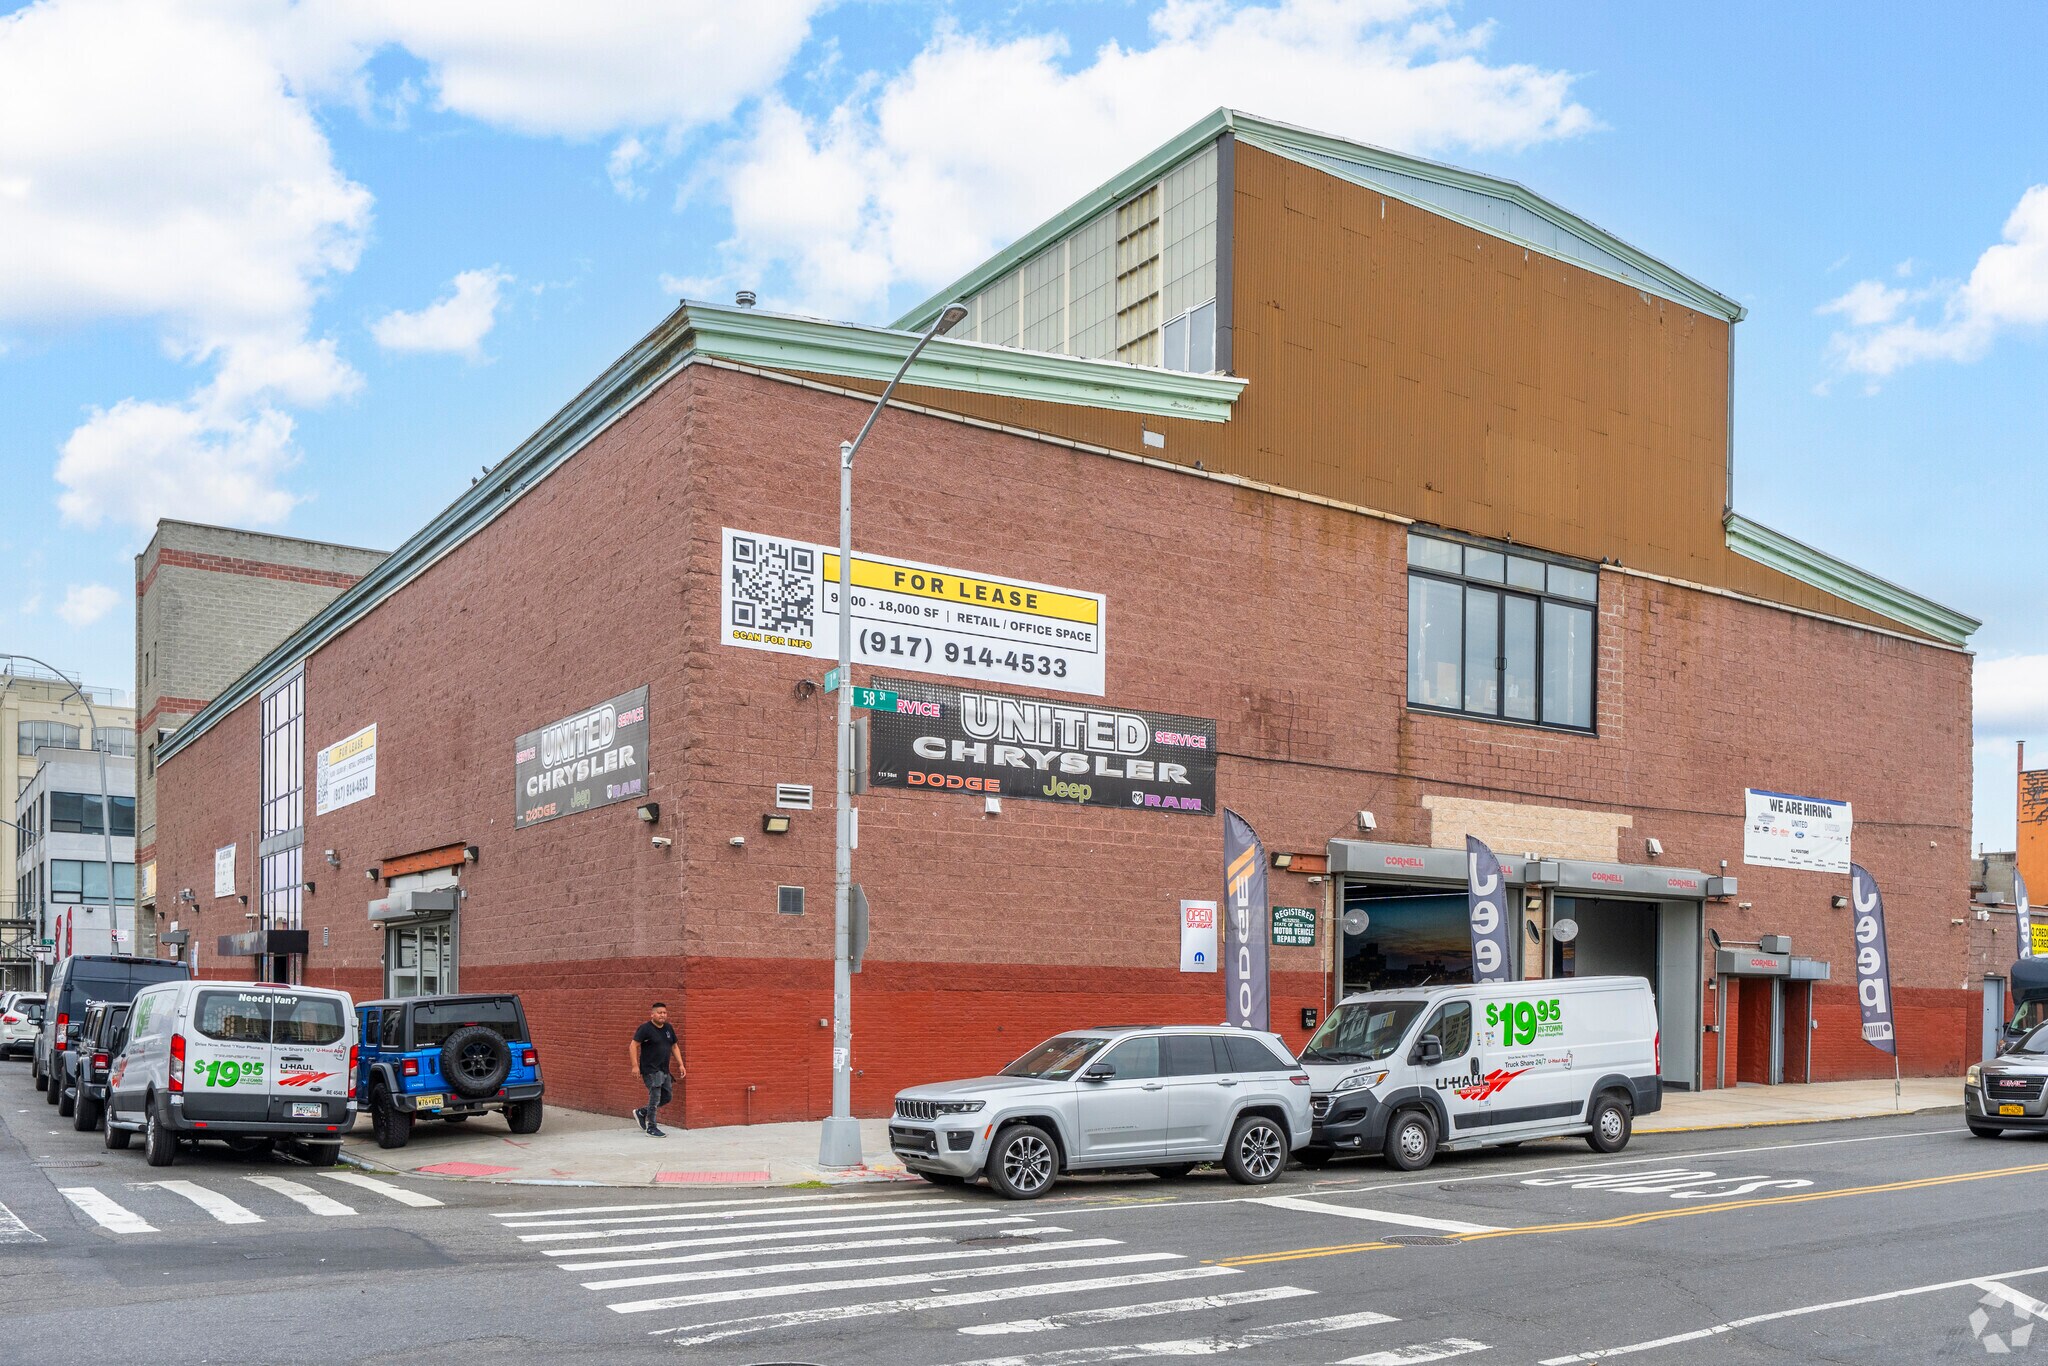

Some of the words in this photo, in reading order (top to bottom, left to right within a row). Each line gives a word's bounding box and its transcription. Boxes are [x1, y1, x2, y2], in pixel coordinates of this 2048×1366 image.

[894, 571, 944, 594] FOR
[960, 582, 1038, 609] LEASE
[830, 593, 866, 607] 900
[878, 600, 920, 615] 18,000
[923, 607, 940, 618] SF
[957, 612, 1000, 629] RETAIL
[1010, 621, 1052, 636] OFFICE
[1055, 628, 1092, 643] SPACE
[733, 629, 761, 642] SCAN
[764, 634, 785, 646] FOR
[788, 637, 812, 649] INFO
[859, 628, 933, 664] (917)
[944, 642, 1067, 678] 914-4533
[863, 690, 875, 706] 58
[896, 699, 940, 718] RVICE
[960, 692, 1150, 756] UNITED
[1154, 730, 1207, 749] SERVICE
[516, 746, 536, 765] SERVICE
[541, 703, 617, 769] UNITED
[617, 706, 644, 729] SERVICE
[348, 737, 363, 754] LEASE
[912, 736, 1192, 785] CHRYSLER
[526, 745, 636, 797] CHRYSLER
[907, 770, 1000, 791] DODGE
[1042, 775, 1092, 803] Jeep
[1144, 793, 1202, 810] RAM
[525, 802, 557, 823] DODGE
[570, 786, 591, 808] Jeep
[612, 778, 641, 799] RAM
[1769, 798, 1783, 813] WE
[1785, 801, 1802, 816] ARE
[1803, 803, 1832, 819] HIRING
[1385, 856, 1424, 867] CORNELL
[1592, 872, 1623, 883] CORNELL
[1668, 879, 1697, 888] CORNELL
[1187, 909, 1211, 921] OPEN
[1274, 908, 1315, 921] REGISTERED
[1273, 927, 1293, 935] MOTOR
[1294, 928, 1314, 936] VEHICLE
[1276, 935, 1296, 944] REPAIR
[1297, 936, 1311, 944] SHOP
[1751, 959, 1778, 968] CORNELL
[238, 993, 265, 1003] Need
[274, 995, 298, 1005] Van?
[1537, 1025, 1563, 1034] IN-TOWN
[1436, 1073, 1490, 1090] U-HAUL
[1999, 1079, 2027, 1087] GMC
